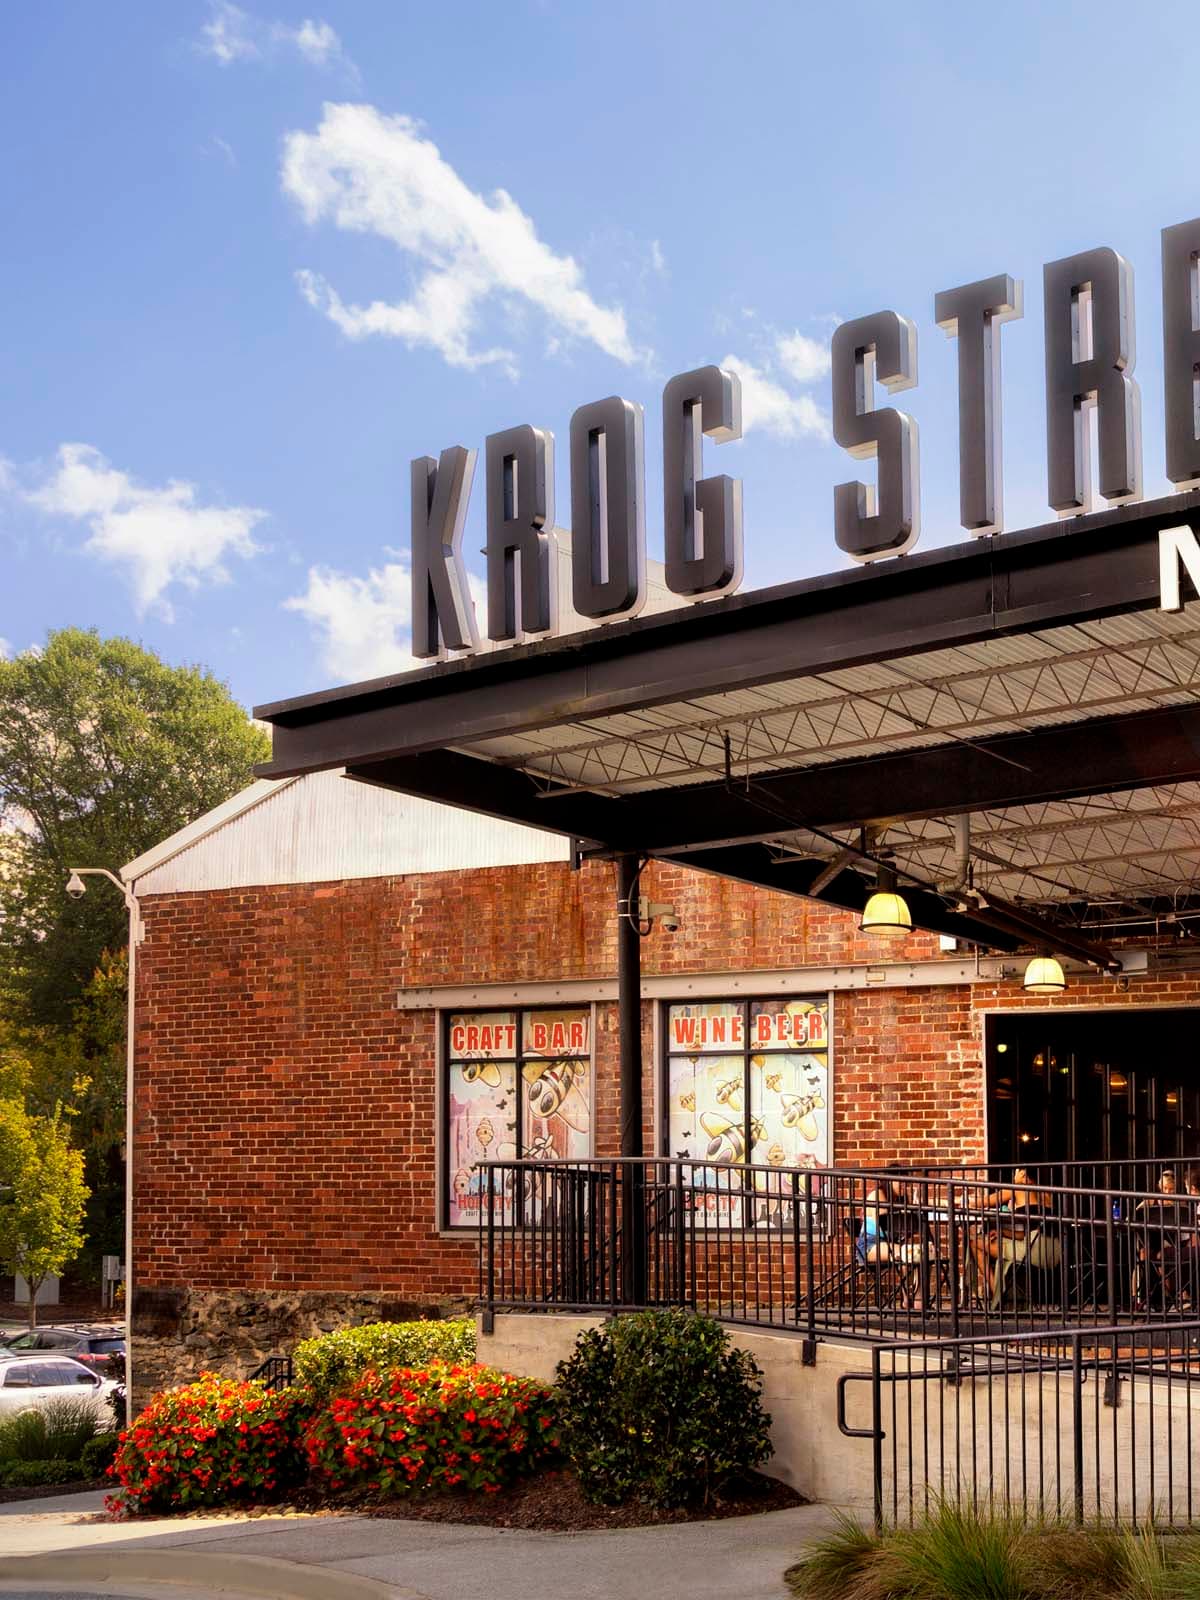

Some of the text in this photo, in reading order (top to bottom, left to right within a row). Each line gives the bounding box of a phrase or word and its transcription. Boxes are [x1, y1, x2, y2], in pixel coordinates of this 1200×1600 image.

[410, 363, 744, 660] KROG
[452, 1022, 583, 1052] CRAFT BAR
[674, 1013, 823, 1044] WINE BEER
